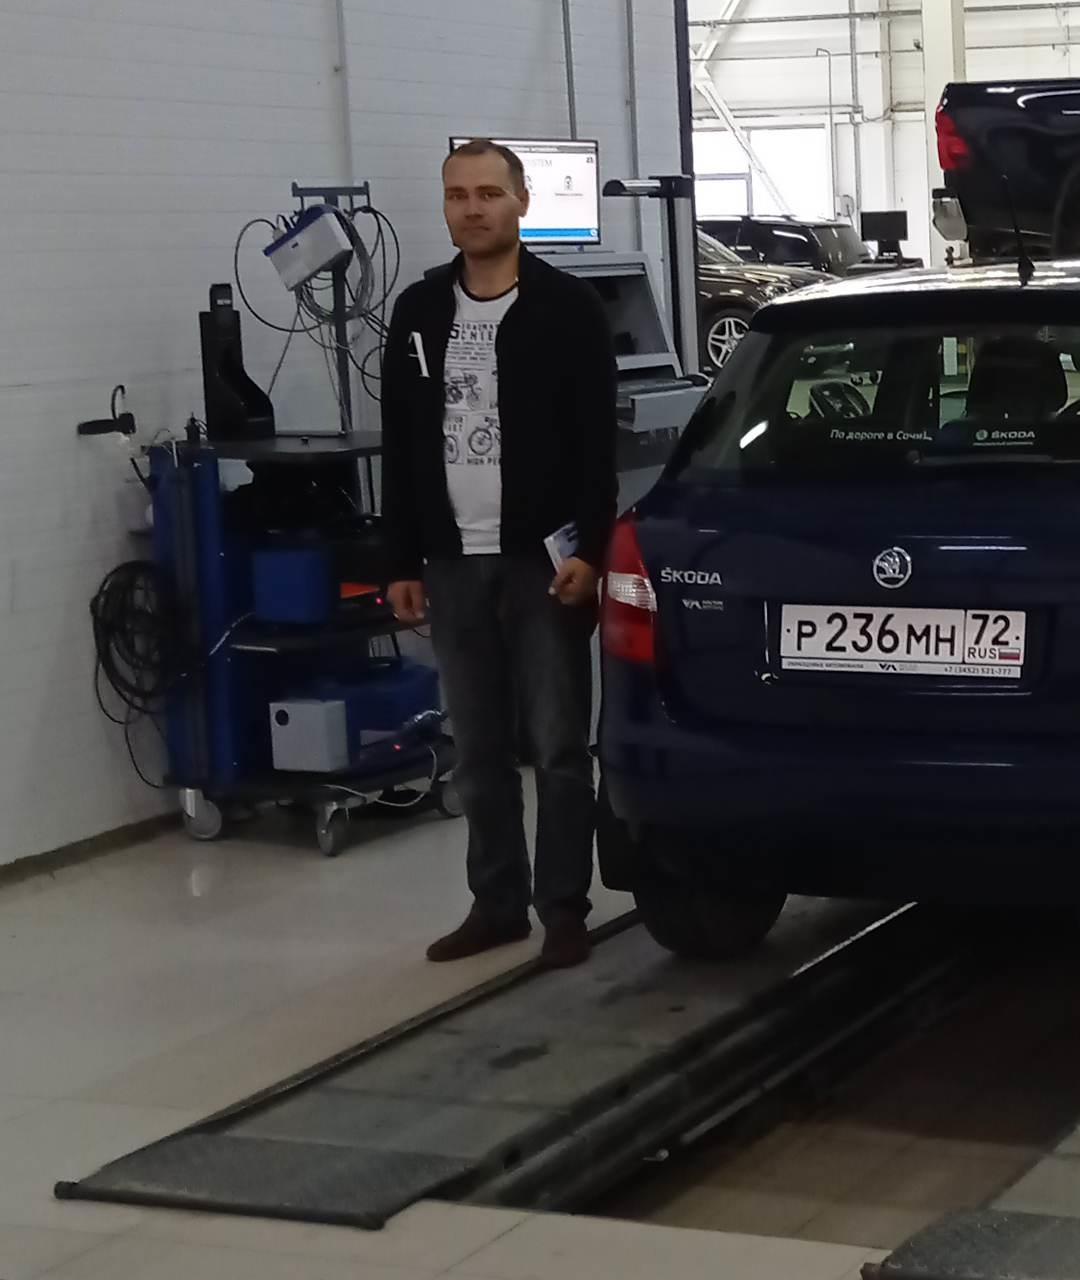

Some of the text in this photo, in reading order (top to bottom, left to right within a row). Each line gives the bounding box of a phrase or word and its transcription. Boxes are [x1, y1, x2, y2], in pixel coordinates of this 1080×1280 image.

[660, 566, 723, 586] ŠKODA
[971, 614, 1011, 647] 72
[967, 647, 998, 660] RUS
